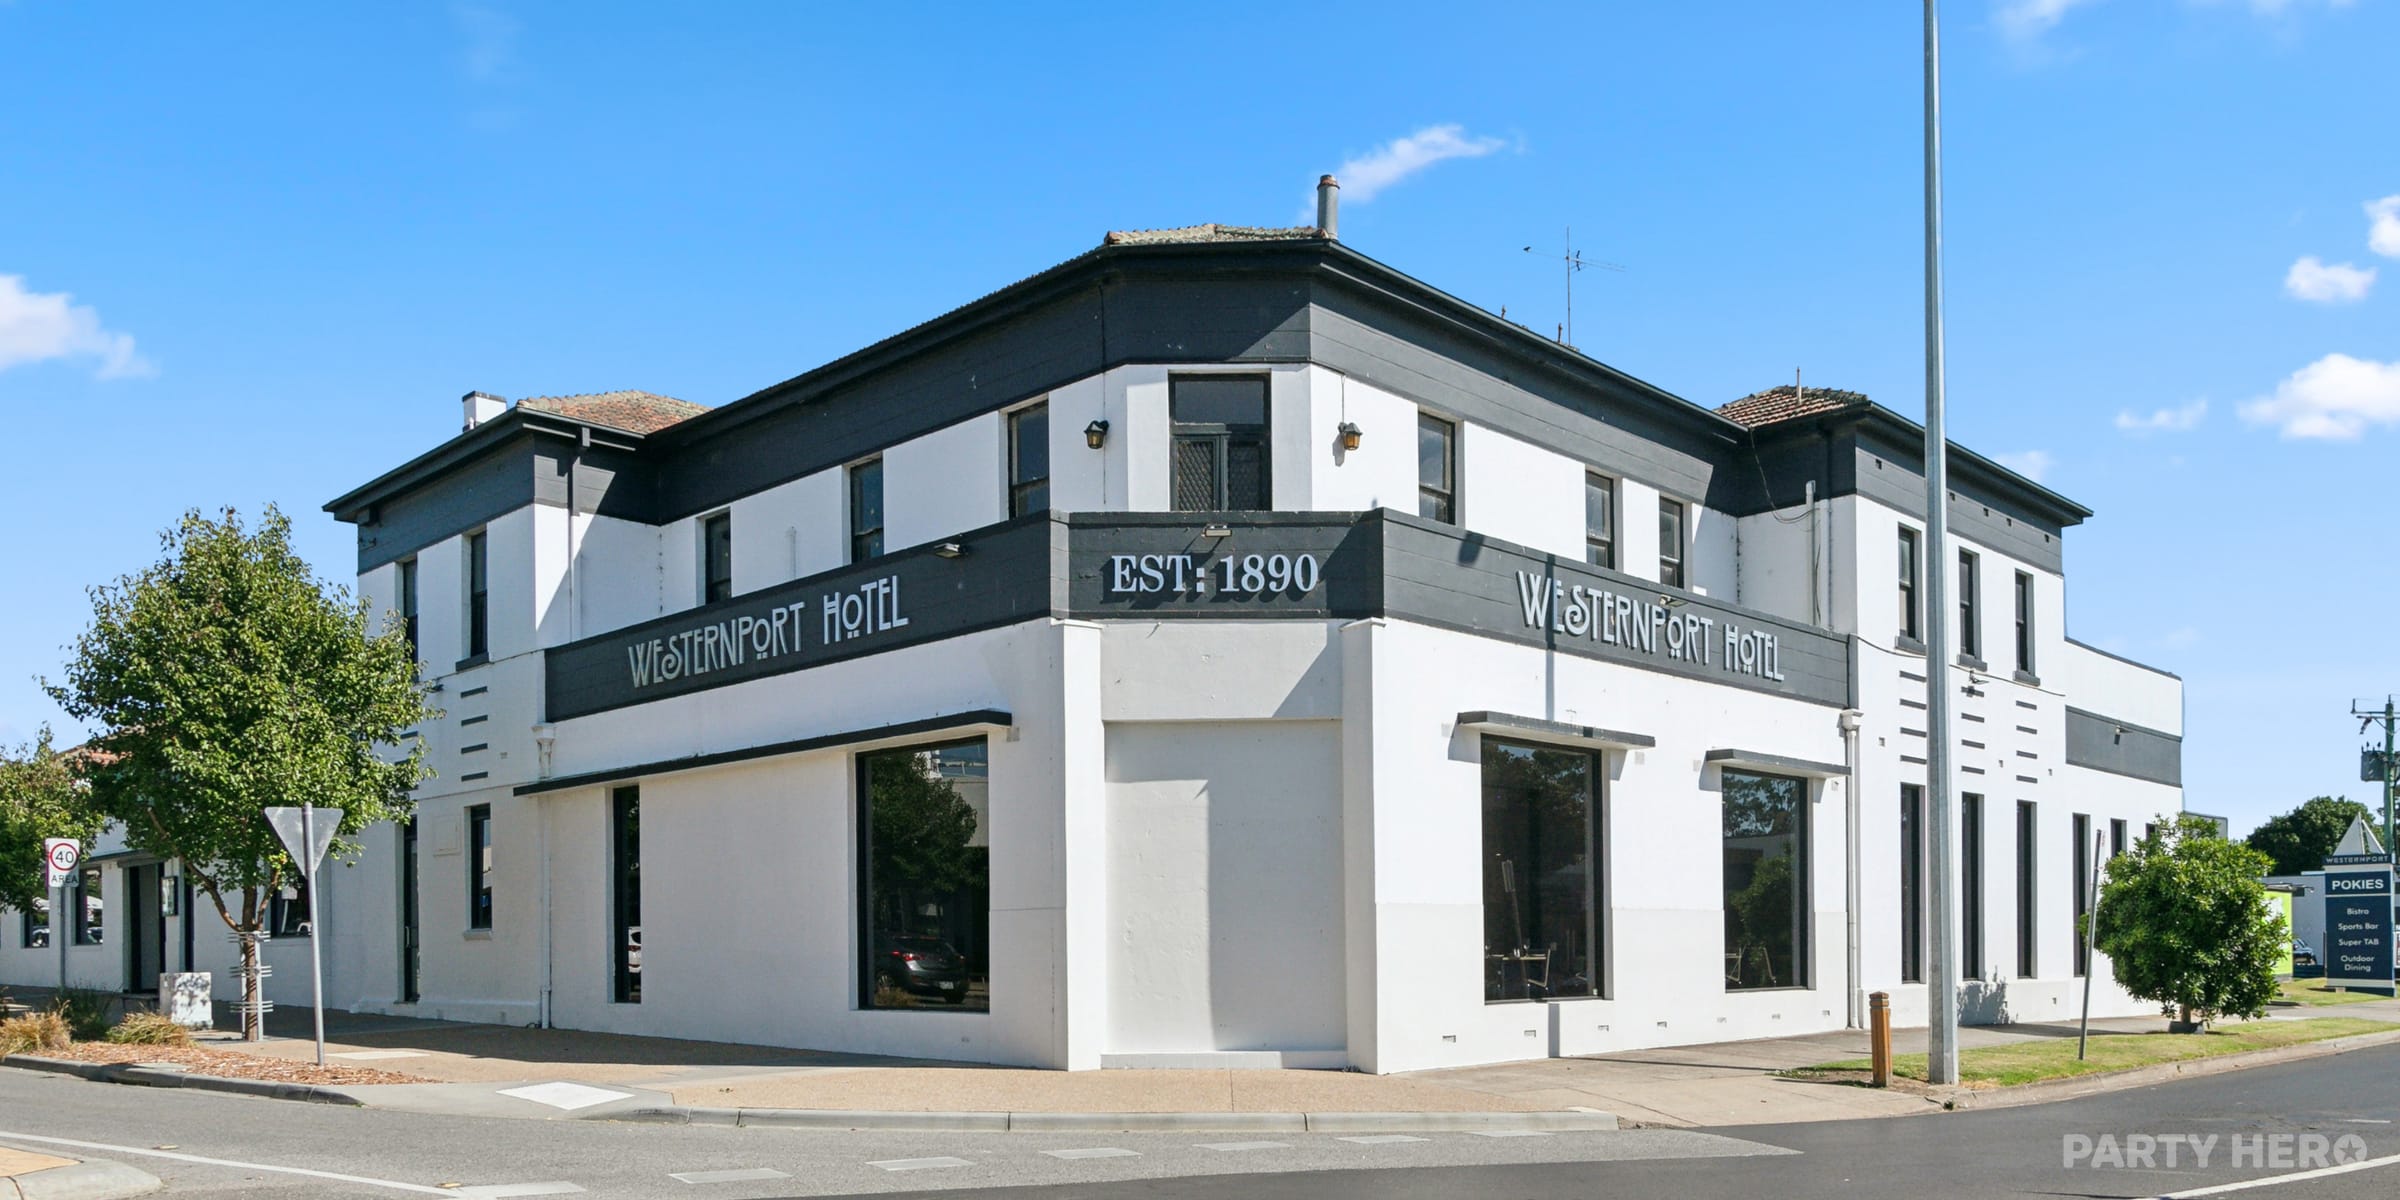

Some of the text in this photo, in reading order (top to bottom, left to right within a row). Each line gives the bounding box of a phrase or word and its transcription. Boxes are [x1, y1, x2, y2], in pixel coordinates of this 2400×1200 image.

[1111, 554, 1319, 593] EST: 1890
[1516, 570, 1785, 681] WESTERNPORT HOTEL
[627, 575, 909, 688] WESTERNPORT HOTEL
[55, 850, 74, 863] 40
[2326, 855, 2389, 864] WESTERNPORT
[51, 874, 79, 884] AREA
[2332, 879, 2384, 891] POKIES
[2346, 907, 2370, 916] Bistro
[2337, 922, 2379, 932] Sports Bar
[2338, 938, 2379, 947] Super TAB
[2340, 954, 2375, 962] Outdoor
[2344, 963, 2372, 973] Dining
